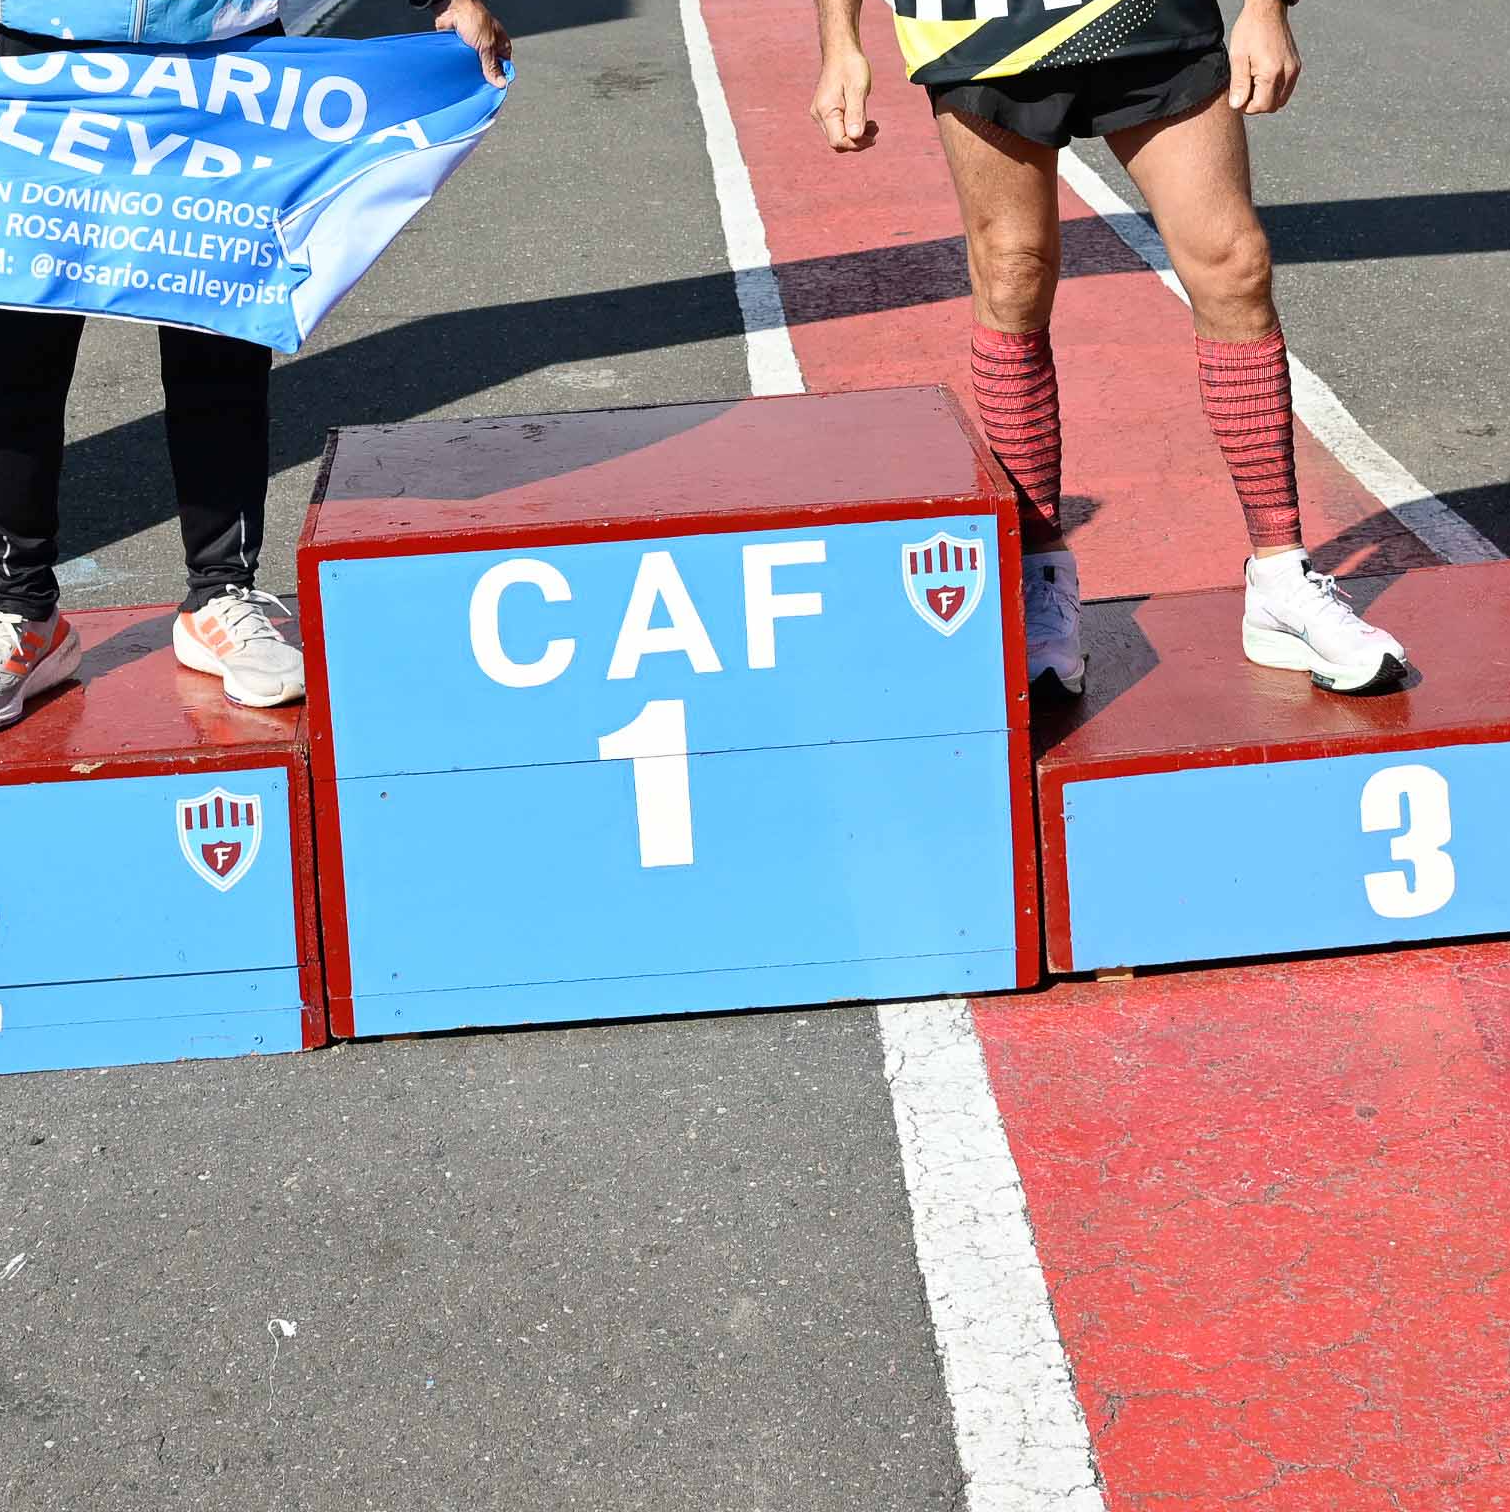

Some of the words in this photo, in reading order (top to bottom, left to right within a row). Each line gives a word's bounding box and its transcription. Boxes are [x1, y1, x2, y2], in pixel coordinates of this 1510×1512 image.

[21, 182, 163, 216] DOMINGO
[30, 254, 289, 307] @rosario.calleypist
[598, 699, 694, 868] 1
[1360, 764, 1456, 918] 3
